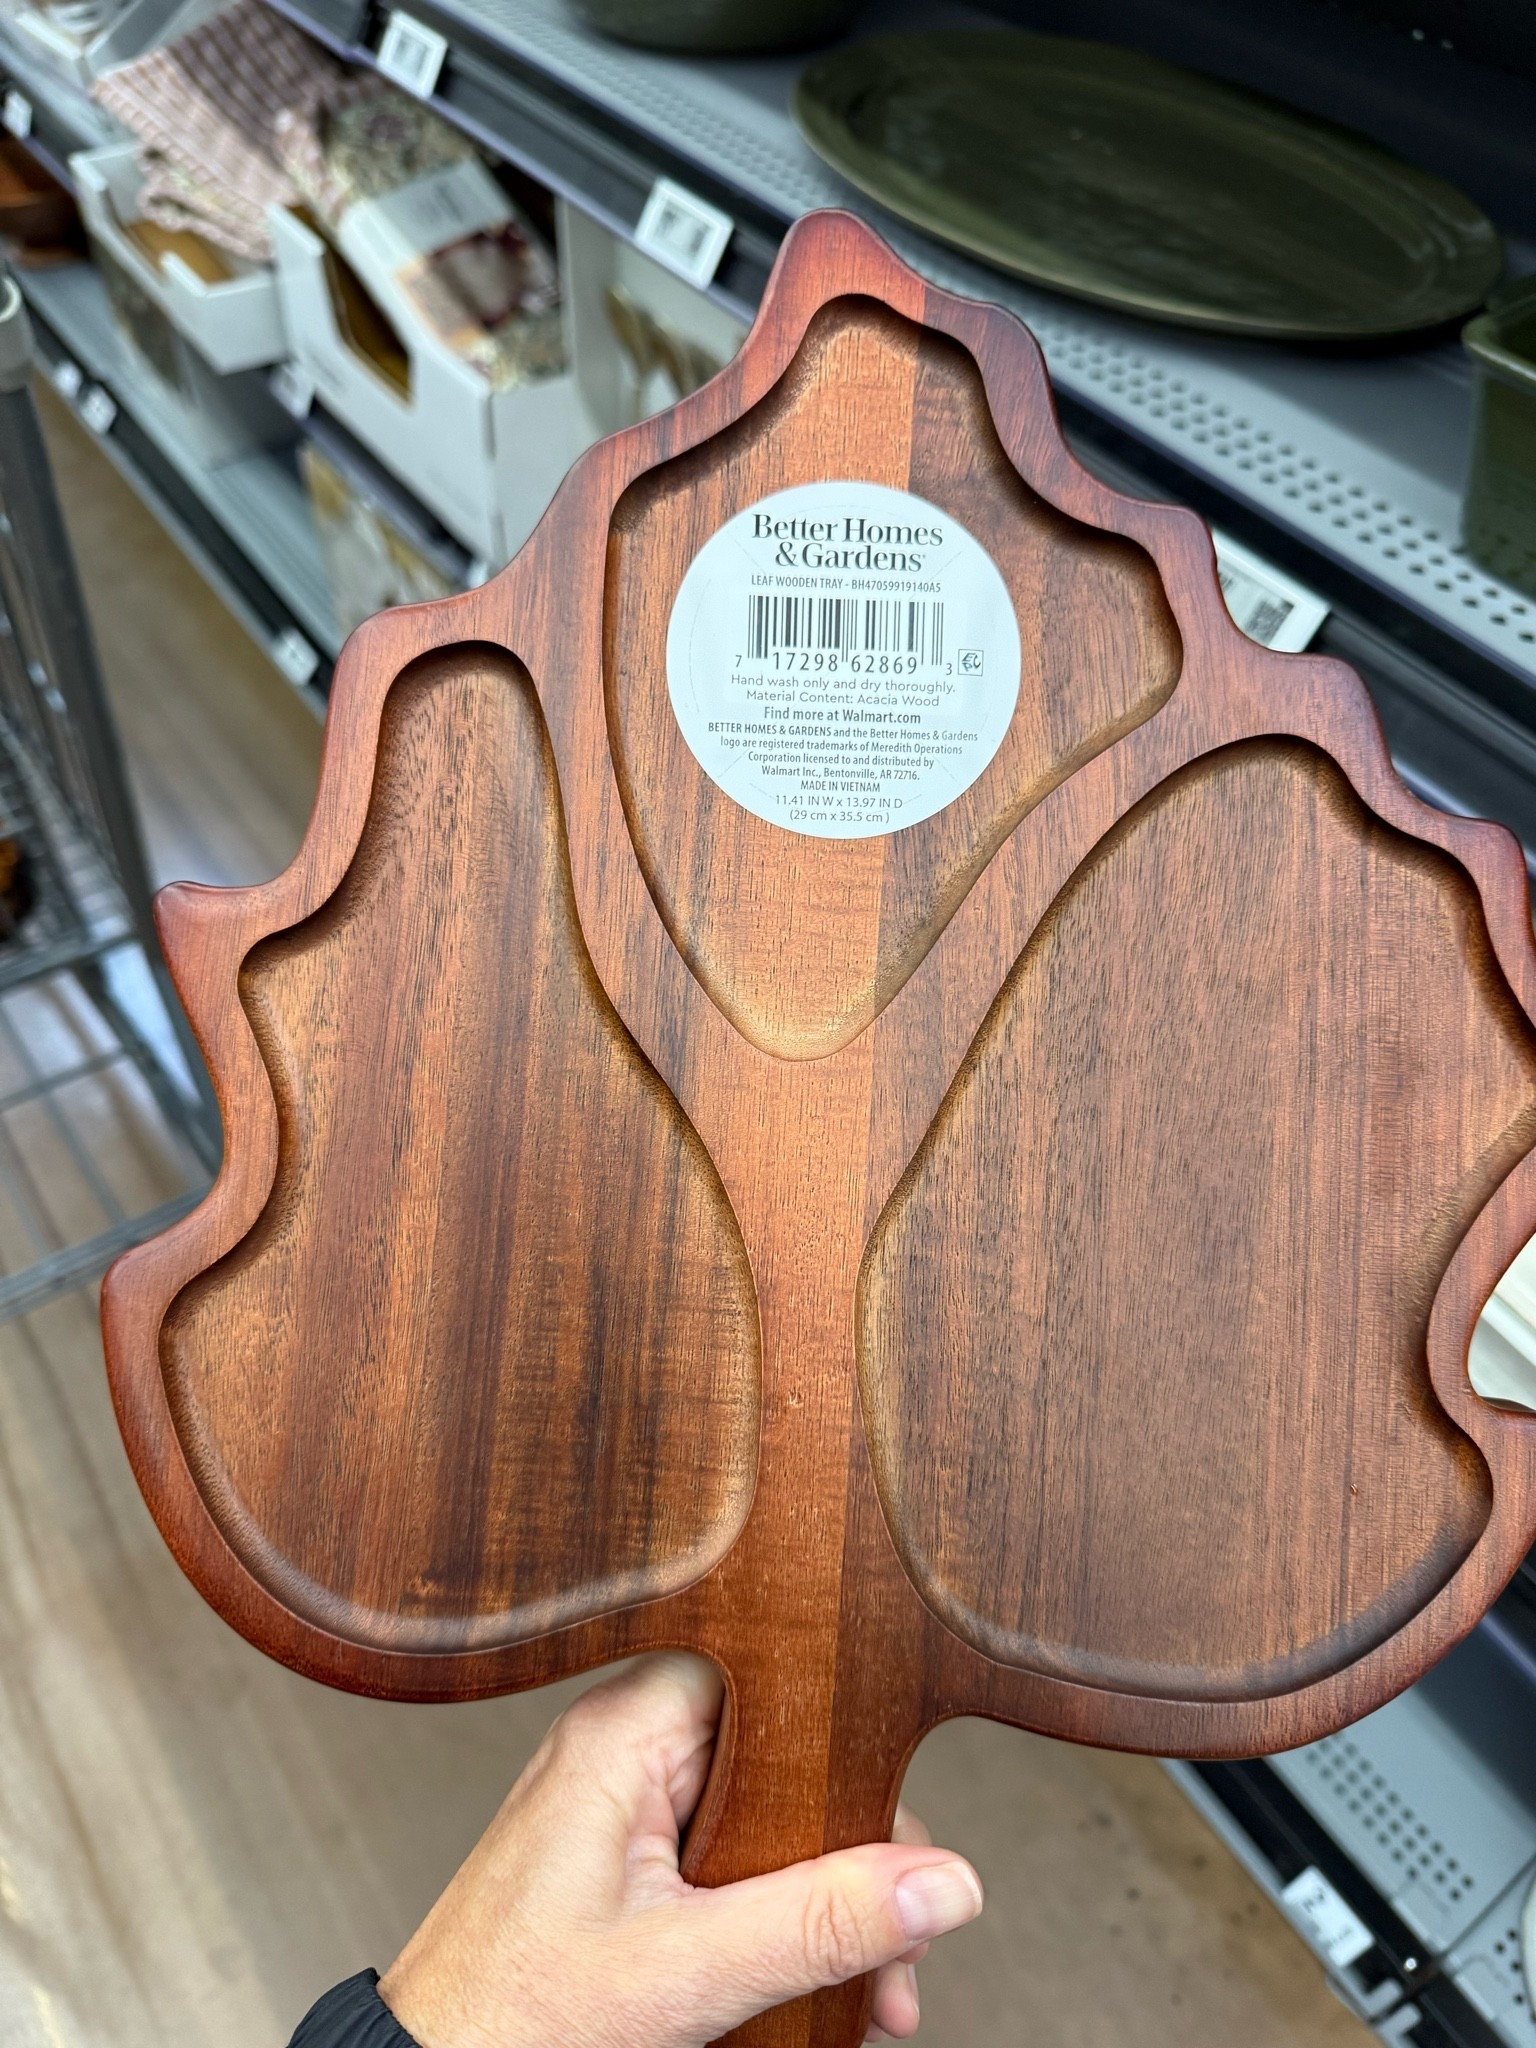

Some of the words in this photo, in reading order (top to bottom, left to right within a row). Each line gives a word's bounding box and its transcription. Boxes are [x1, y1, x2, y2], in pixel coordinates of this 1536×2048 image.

[752, 514, 838, 542] Better
[843, 518, 943, 546] Homes
[775, 542, 798, 567] &
[802, 543, 922, 572] Gardens
[752, 575, 774, 586] LEAF
[776, 576, 817, 588] WOODEN
[820, 578, 843, 589] TRAY
[735, 655, 742, 667] 7
[773, 652, 838, 672] 17298
[851, 655, 917, 675] 62869
[946, 663, 953, 676] 3
[731, 675, 763, 686] Hand
[767, 676, 799, 688] wash
[803, 677, 830, 690] only
[833, 678, 857, 690] and
[861, 679, 881, 692] dry
[885, 680, 956, 694] thoroughly.
[746, 690, 795, 702] Material
[799, 692, 854, 704] Content:
[857, 694, 898, 706] Acacia
[902, 695, 939, 707] Wood
[764, 707, 790, 720] Find
[793, 710, 824, 721] more
[827, 710, 839, 721] at
[843, 709, 921, 725] Walmart.com
[708, 723, 742, 734] BETTER
[744, 724, 777, 735] HOMES
[779, 725, 786, 735] &
[789, 725, 831, 737] GARDENS
[834, 727, 850, 738] and
[852, 728, 868, 739] the
[870, 728, 898, 740] Better
[900, 729, 930, 740] Homes
[932, 730, 939, 741] &
[941, 731, 978, 742] Gardens
[721, 736, 740, 749] logo
[743, 739, 757, 748] are
[759, 738, 804, 750] registered
[807, 740, 857, 752] trademarks
[860, 741, 869, 752] of
[871, 742, 912, 753] Meredith
[914, 744, 962, 757] Operations
[748, 751, 800, 764] Corporation
[803, 754, 839, 766] licensed
[842, 755, 851, 766] to
[853, 755, 870, 767] and
[872, 756, 921, 768] distributed
[924, 757, 934, 770] by
[762, 765, 800, 777] Walmart
[803, 766, 821, 778] Inc.,
[824, 767, 877, 780] Bentonville,
[880, 769, 892, 780] AR
[894, 770, 920, 780] 72716.
[800, 780, 827, 792] MADE
[829, 780, 838, 792] IN
[840, 781, 881, 793] VIETNAM
[776, 795, 803, 806] 11.41
[808, 795, 820, 807] IN
[822, 795, 834, 807] W
[836, 799, 842, 808] x
[847, 797, 876, 808] 13.97
[879, 798, 891, 809] IN
[894, 798, 903, 809] D
[810, 812, 826, 821] cm
[830, 813, 837, 822] x
[839, 812, 862, 822] 35.5
[866, 813, 882, 823] cm
